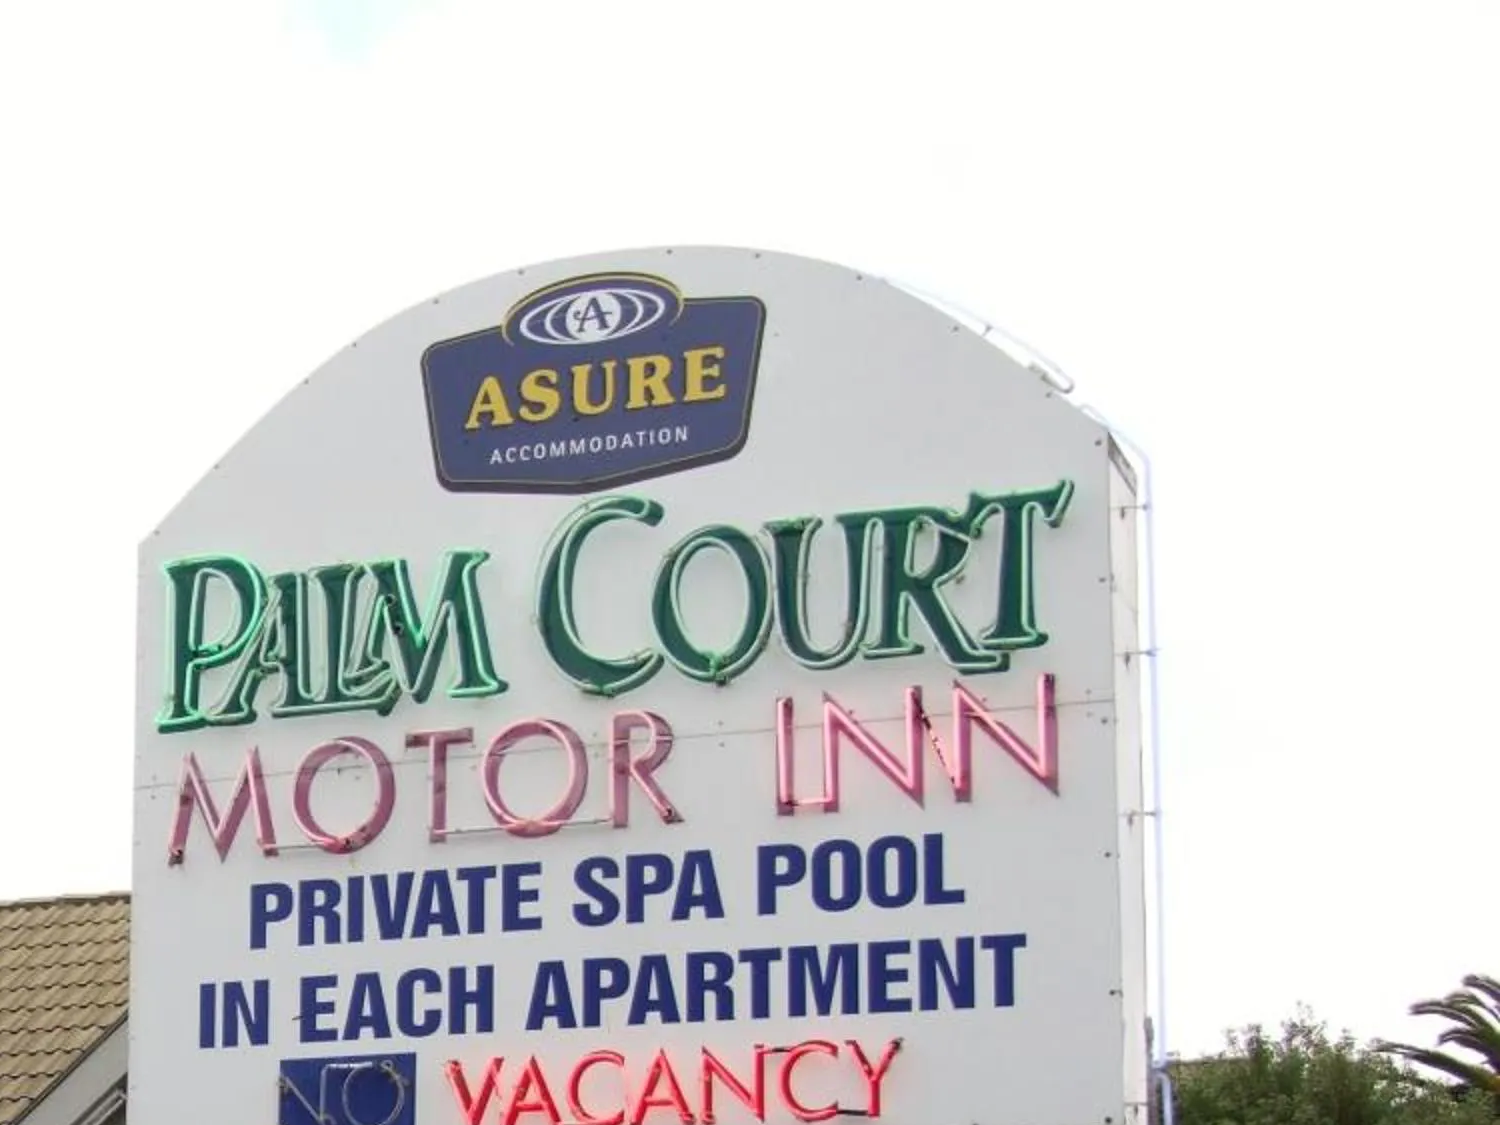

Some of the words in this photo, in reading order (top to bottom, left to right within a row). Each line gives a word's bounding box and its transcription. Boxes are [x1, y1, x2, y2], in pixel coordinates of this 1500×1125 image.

[464, 345, 727, 430] ASURE
[489, 425, 689, 465] ACCOMMODATION
[156, 549, 508, 734] PALM
[534, 479, 1076, 697] COURT
[168, 709, 684, 868] MOTOR
[775, 672, 1060, 817] INN
[249, 861, 543, 949] PRIVATE
[572, 850, 725, 927] SPA
[757, 833, 966, 915] POOL
[199, 980, 269, 1048] IN
[300, 964, 494, 1042] EACH
[525, 932, 1027, 1031] APARTMENT
